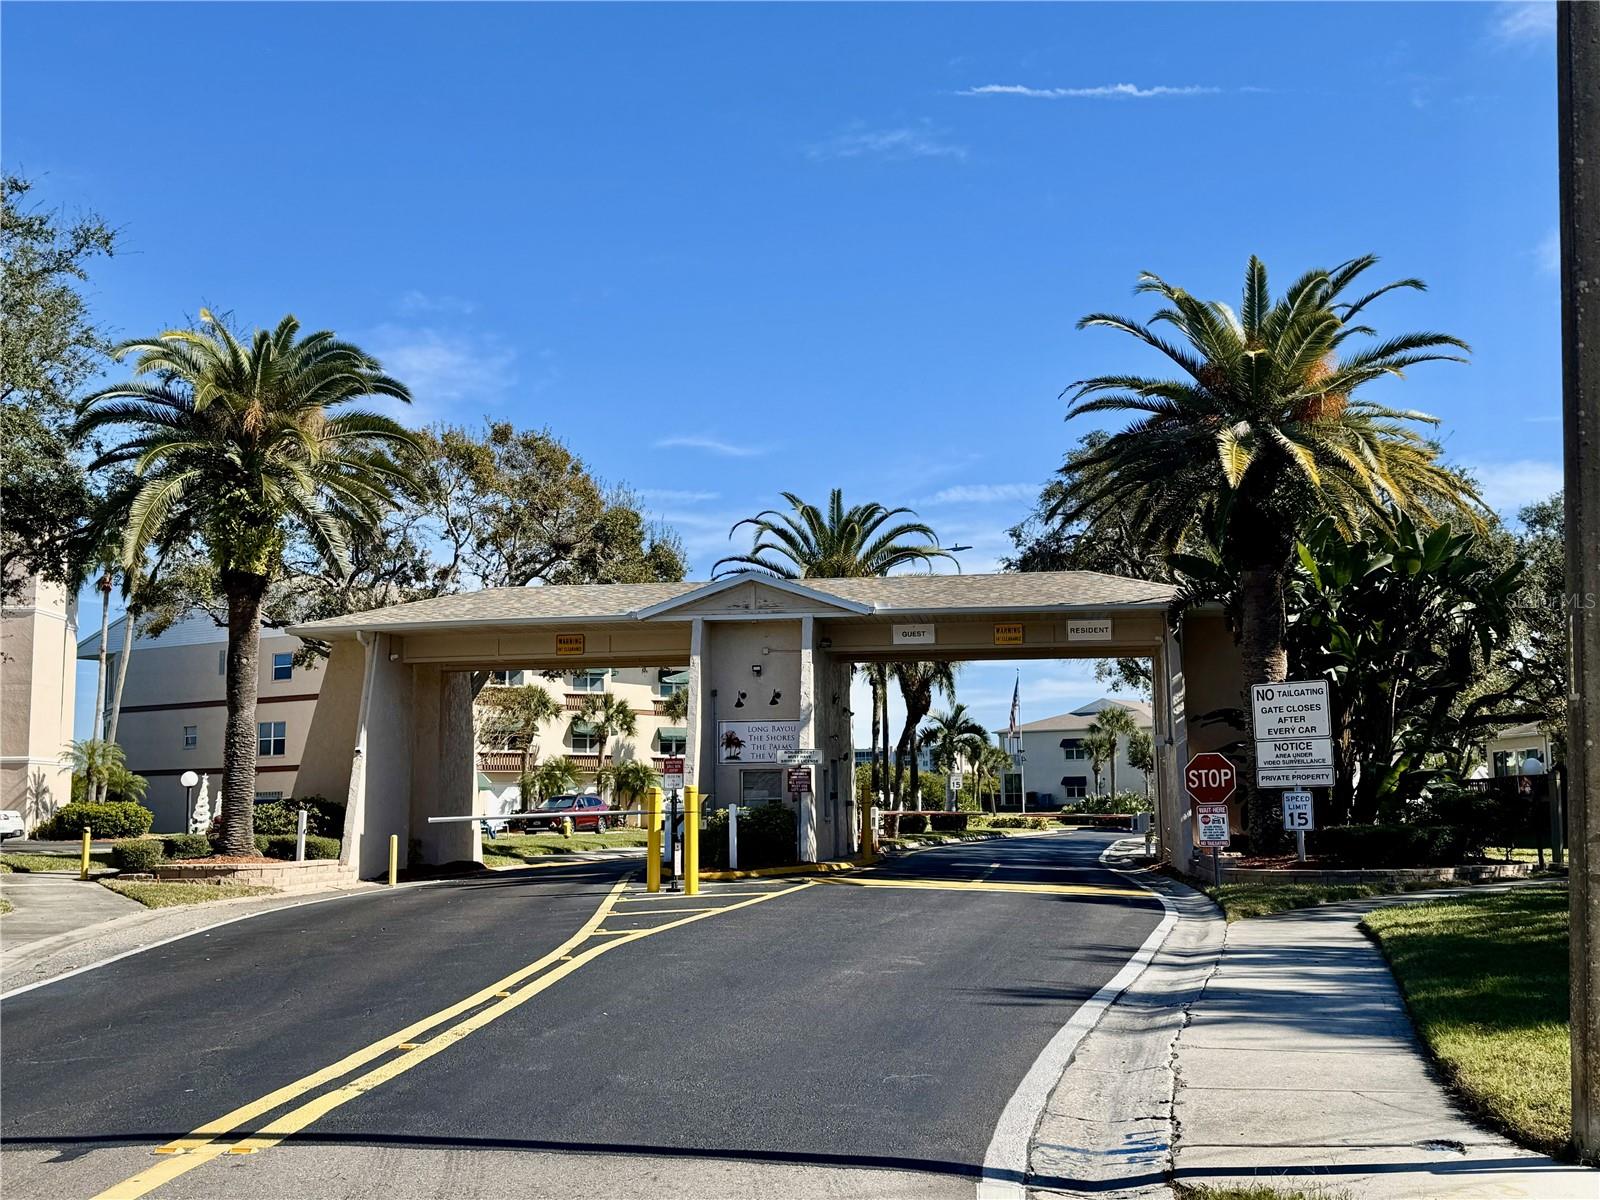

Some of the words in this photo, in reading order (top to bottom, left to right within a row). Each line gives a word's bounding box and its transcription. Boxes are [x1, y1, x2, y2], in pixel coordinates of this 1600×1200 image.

[1256, 689, 1274, 701] NO
[1277, 688, 1324, 697] TAILGATING
[1261, 706, 1284, 714] GATE
[1286, 704, 1321, 713] CLOSES
[1278, 716, 1305, 724] AFTER
[1268, 727, 1295, 735] EVERY
[1274, 742, 1312, 751] NOTICE
[1188, 769, 1232, 788] STOP
[1289, 812, 1308, 827] 15
